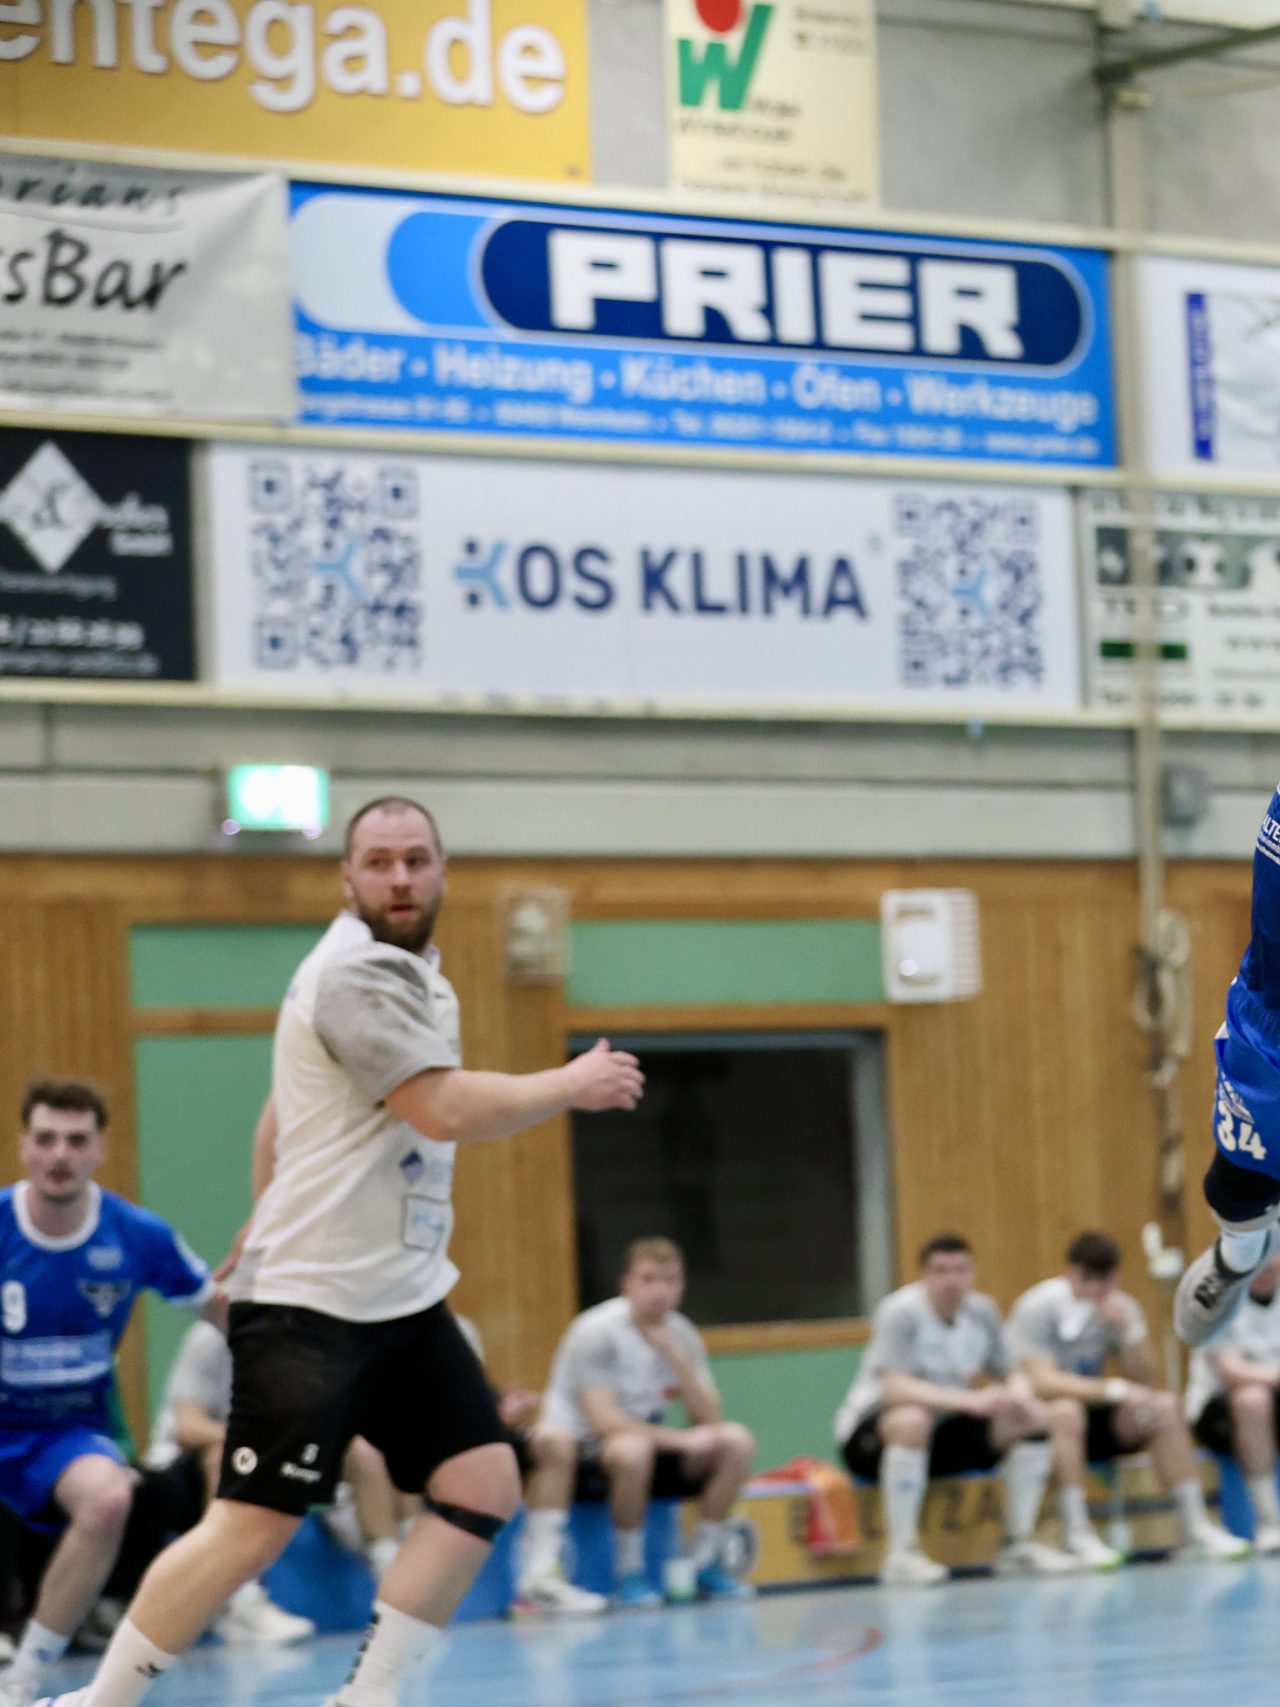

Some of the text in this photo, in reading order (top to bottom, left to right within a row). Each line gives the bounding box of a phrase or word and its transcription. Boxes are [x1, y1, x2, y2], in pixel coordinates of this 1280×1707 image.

[547, 227, 1025, 360] PRIER
[431, 343, 593, 403] Heizung
[620, 356, 766, 406] Küchen
[792, 360, 881, 411] Öfen
[905, 374, 1099, 432] Werkzeuge
[639, 545, 870, 620] KLIMA
